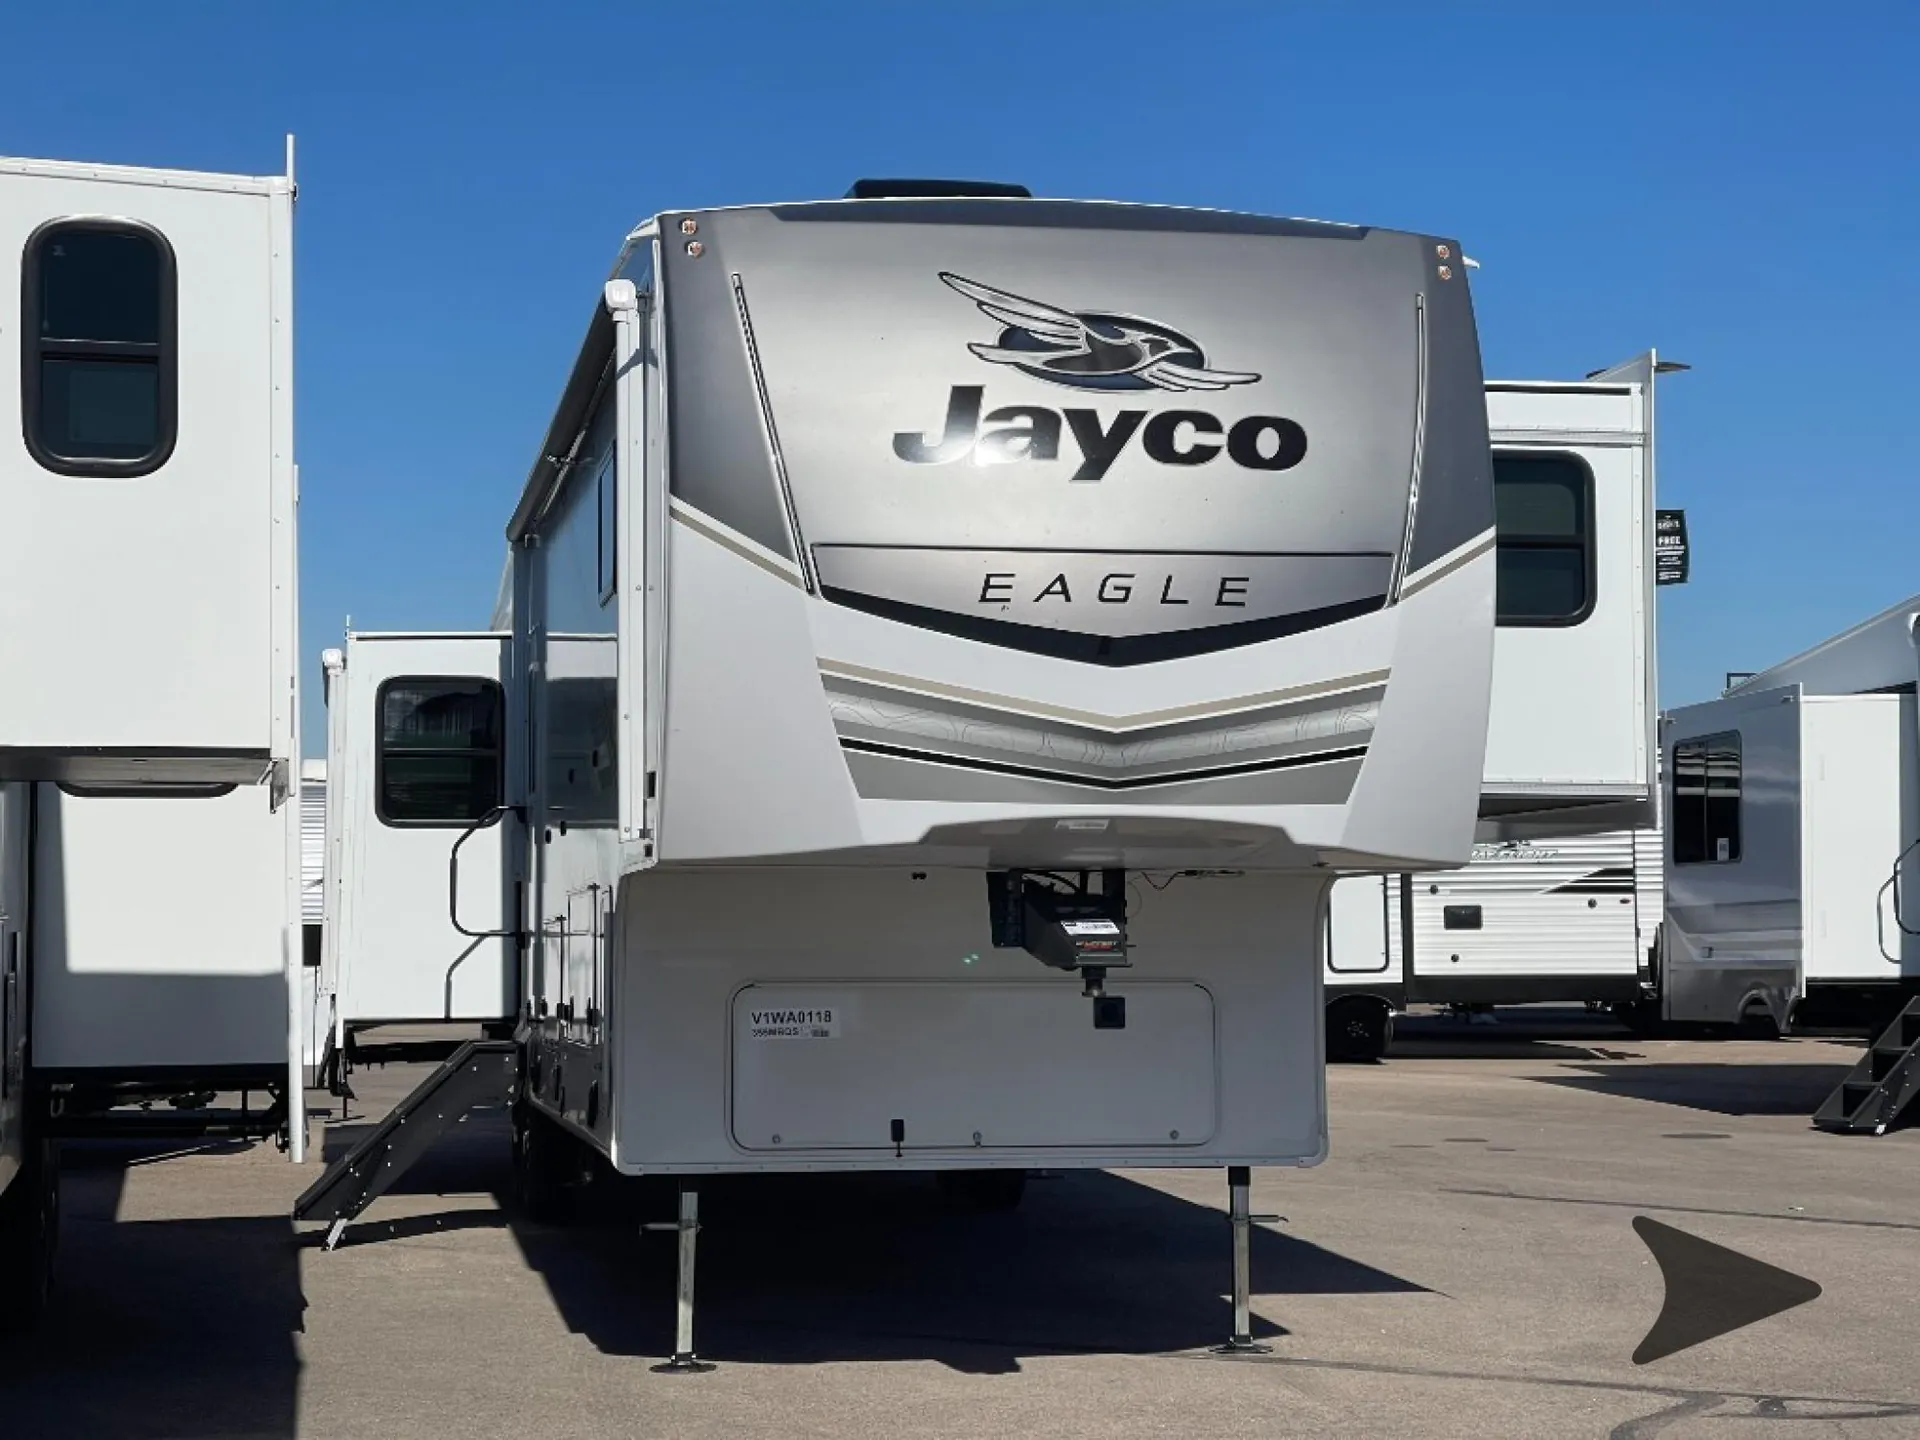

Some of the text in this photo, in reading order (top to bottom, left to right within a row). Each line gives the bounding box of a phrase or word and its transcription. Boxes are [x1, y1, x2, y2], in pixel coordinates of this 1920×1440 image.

[892, 384, 1308, 481] Jayco
[978, 573, 1250, 607] EAGLE
[751, 1010, 832, 1025] V1WA0118
